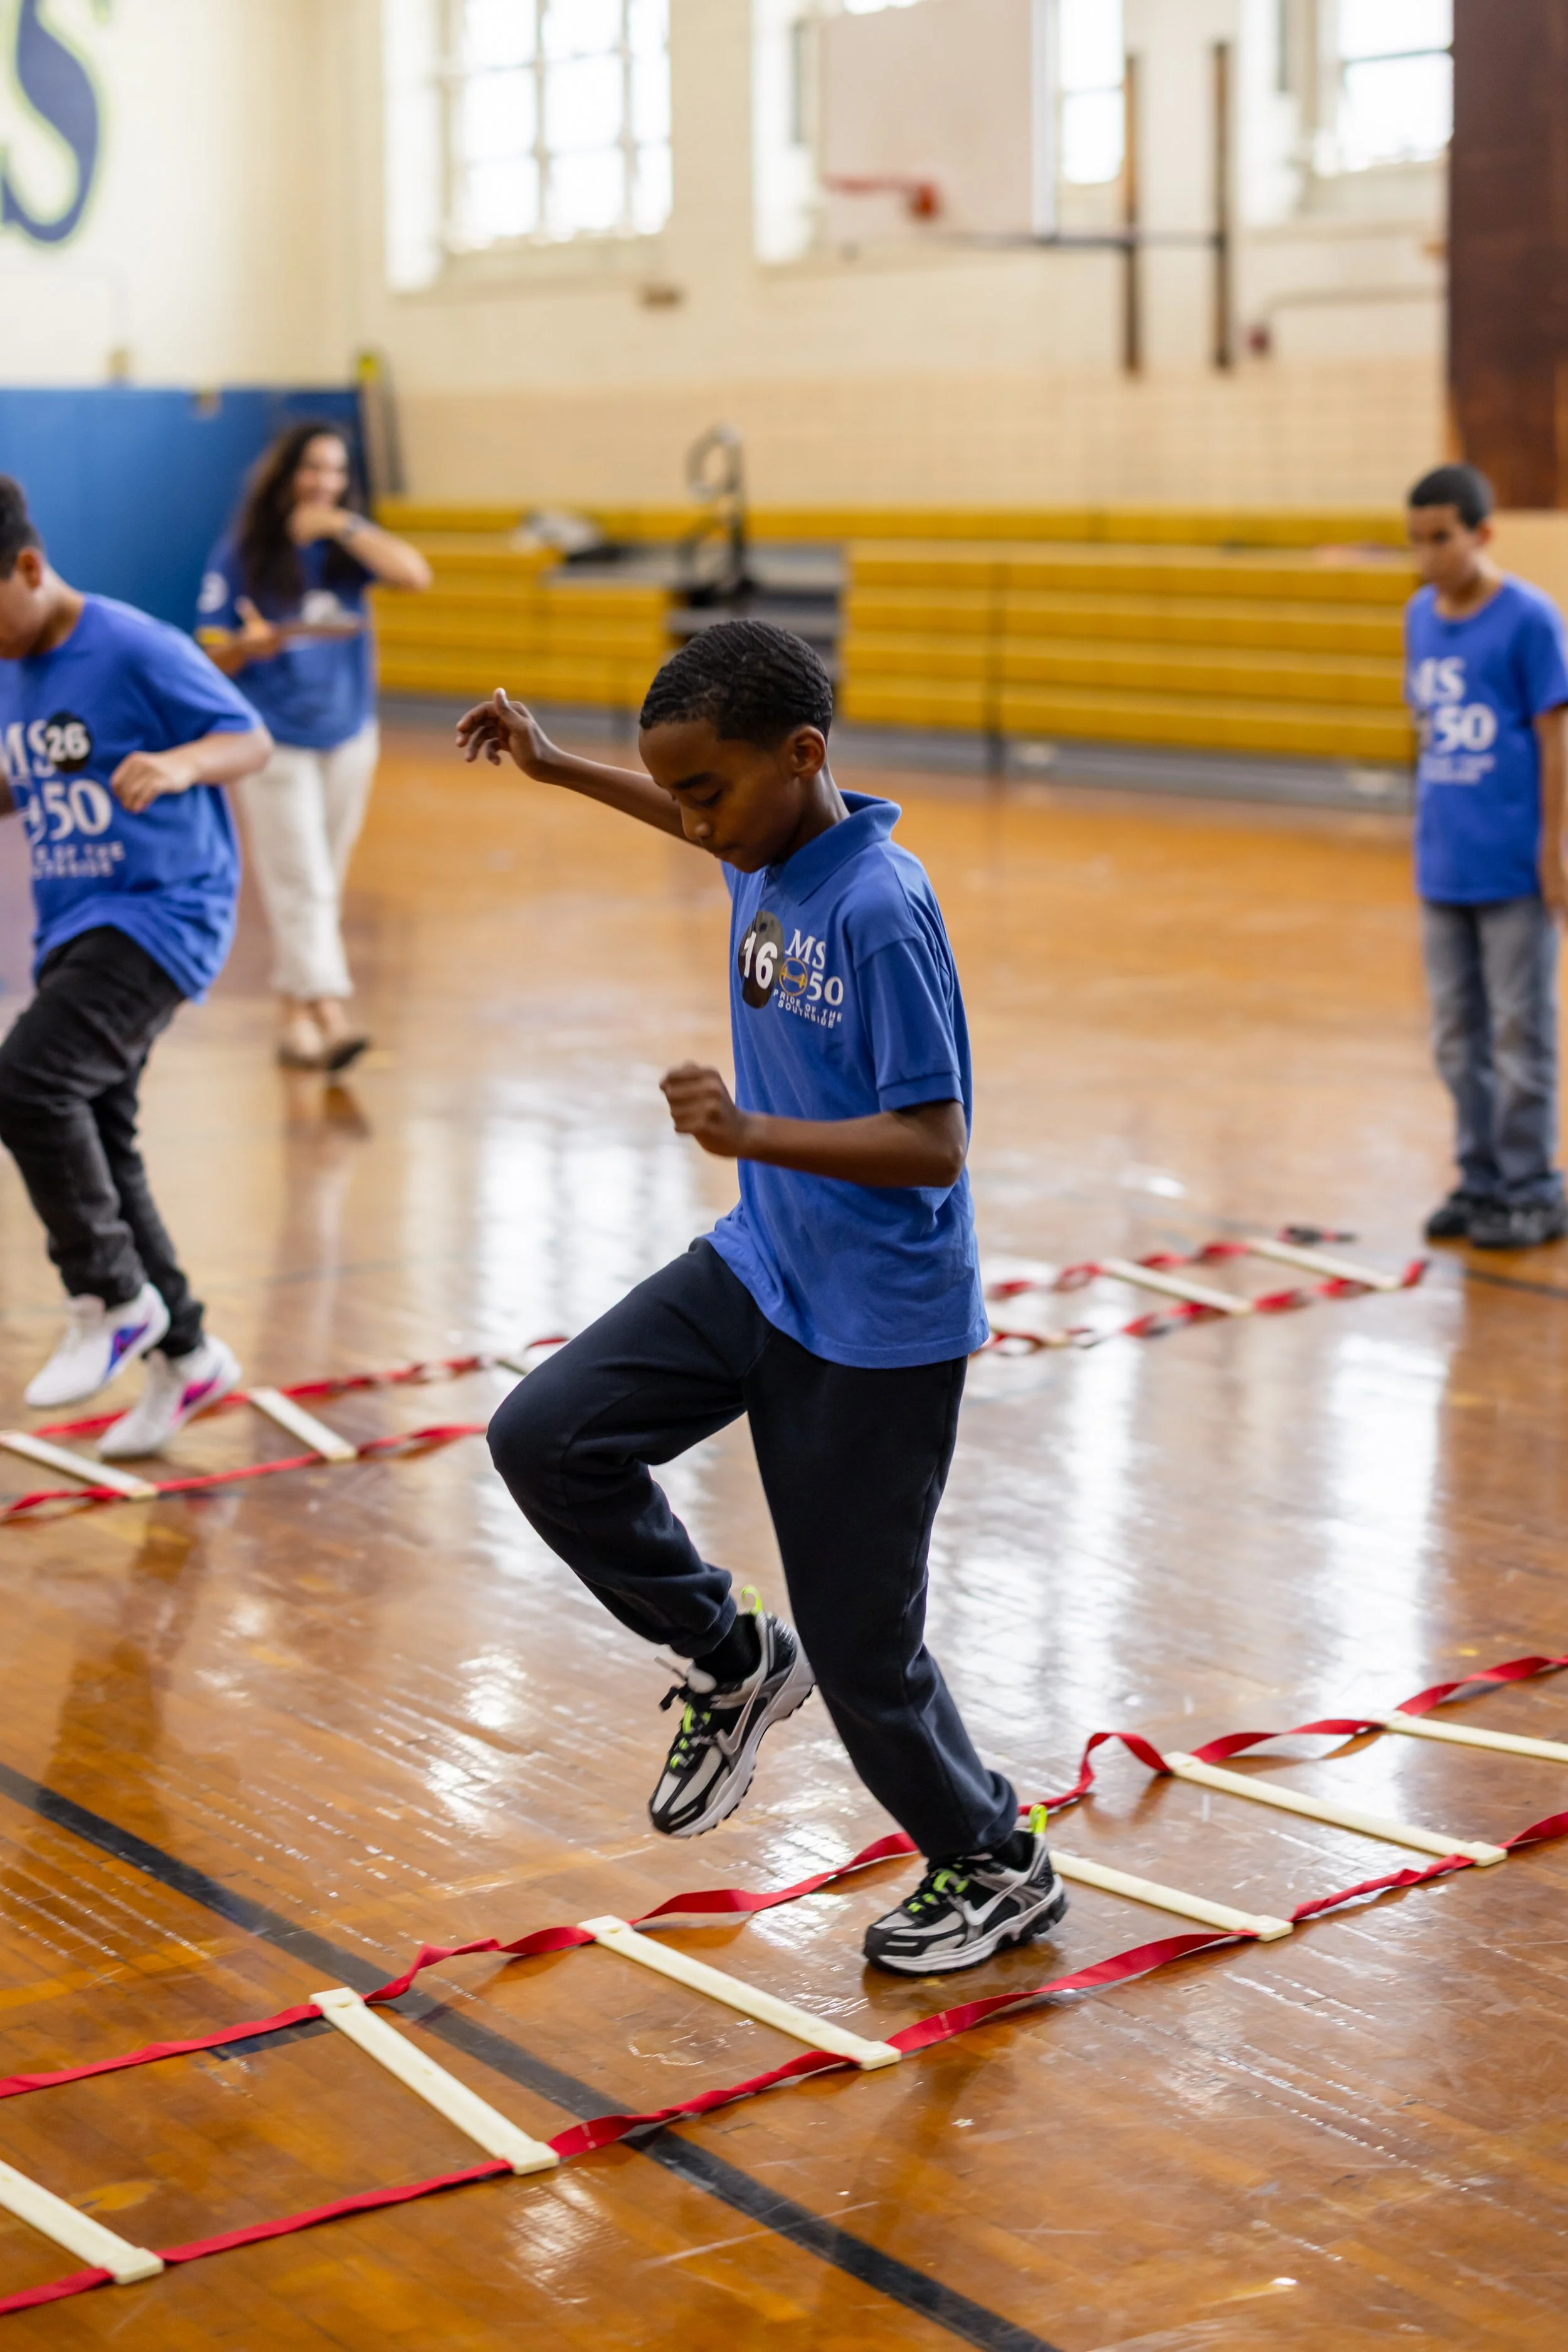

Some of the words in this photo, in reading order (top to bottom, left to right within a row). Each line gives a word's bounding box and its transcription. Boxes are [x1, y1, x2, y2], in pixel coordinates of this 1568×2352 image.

[45, 722, 91, 762] 26
[1434, 704, 1497, 753] 50
[42, 779, 114, 840] 50
[744, 931, 778, 990] 16
[785, 928, 827, 970] MS
[773, 988, 801, 1008] PRIDE
[805, 1003, 817, 1014] OF
[822, 1008, 842, 1022] THE
[807, 971, 844, 1006] 50
[778, 999, 834, 1029] SOUTHSIDE
